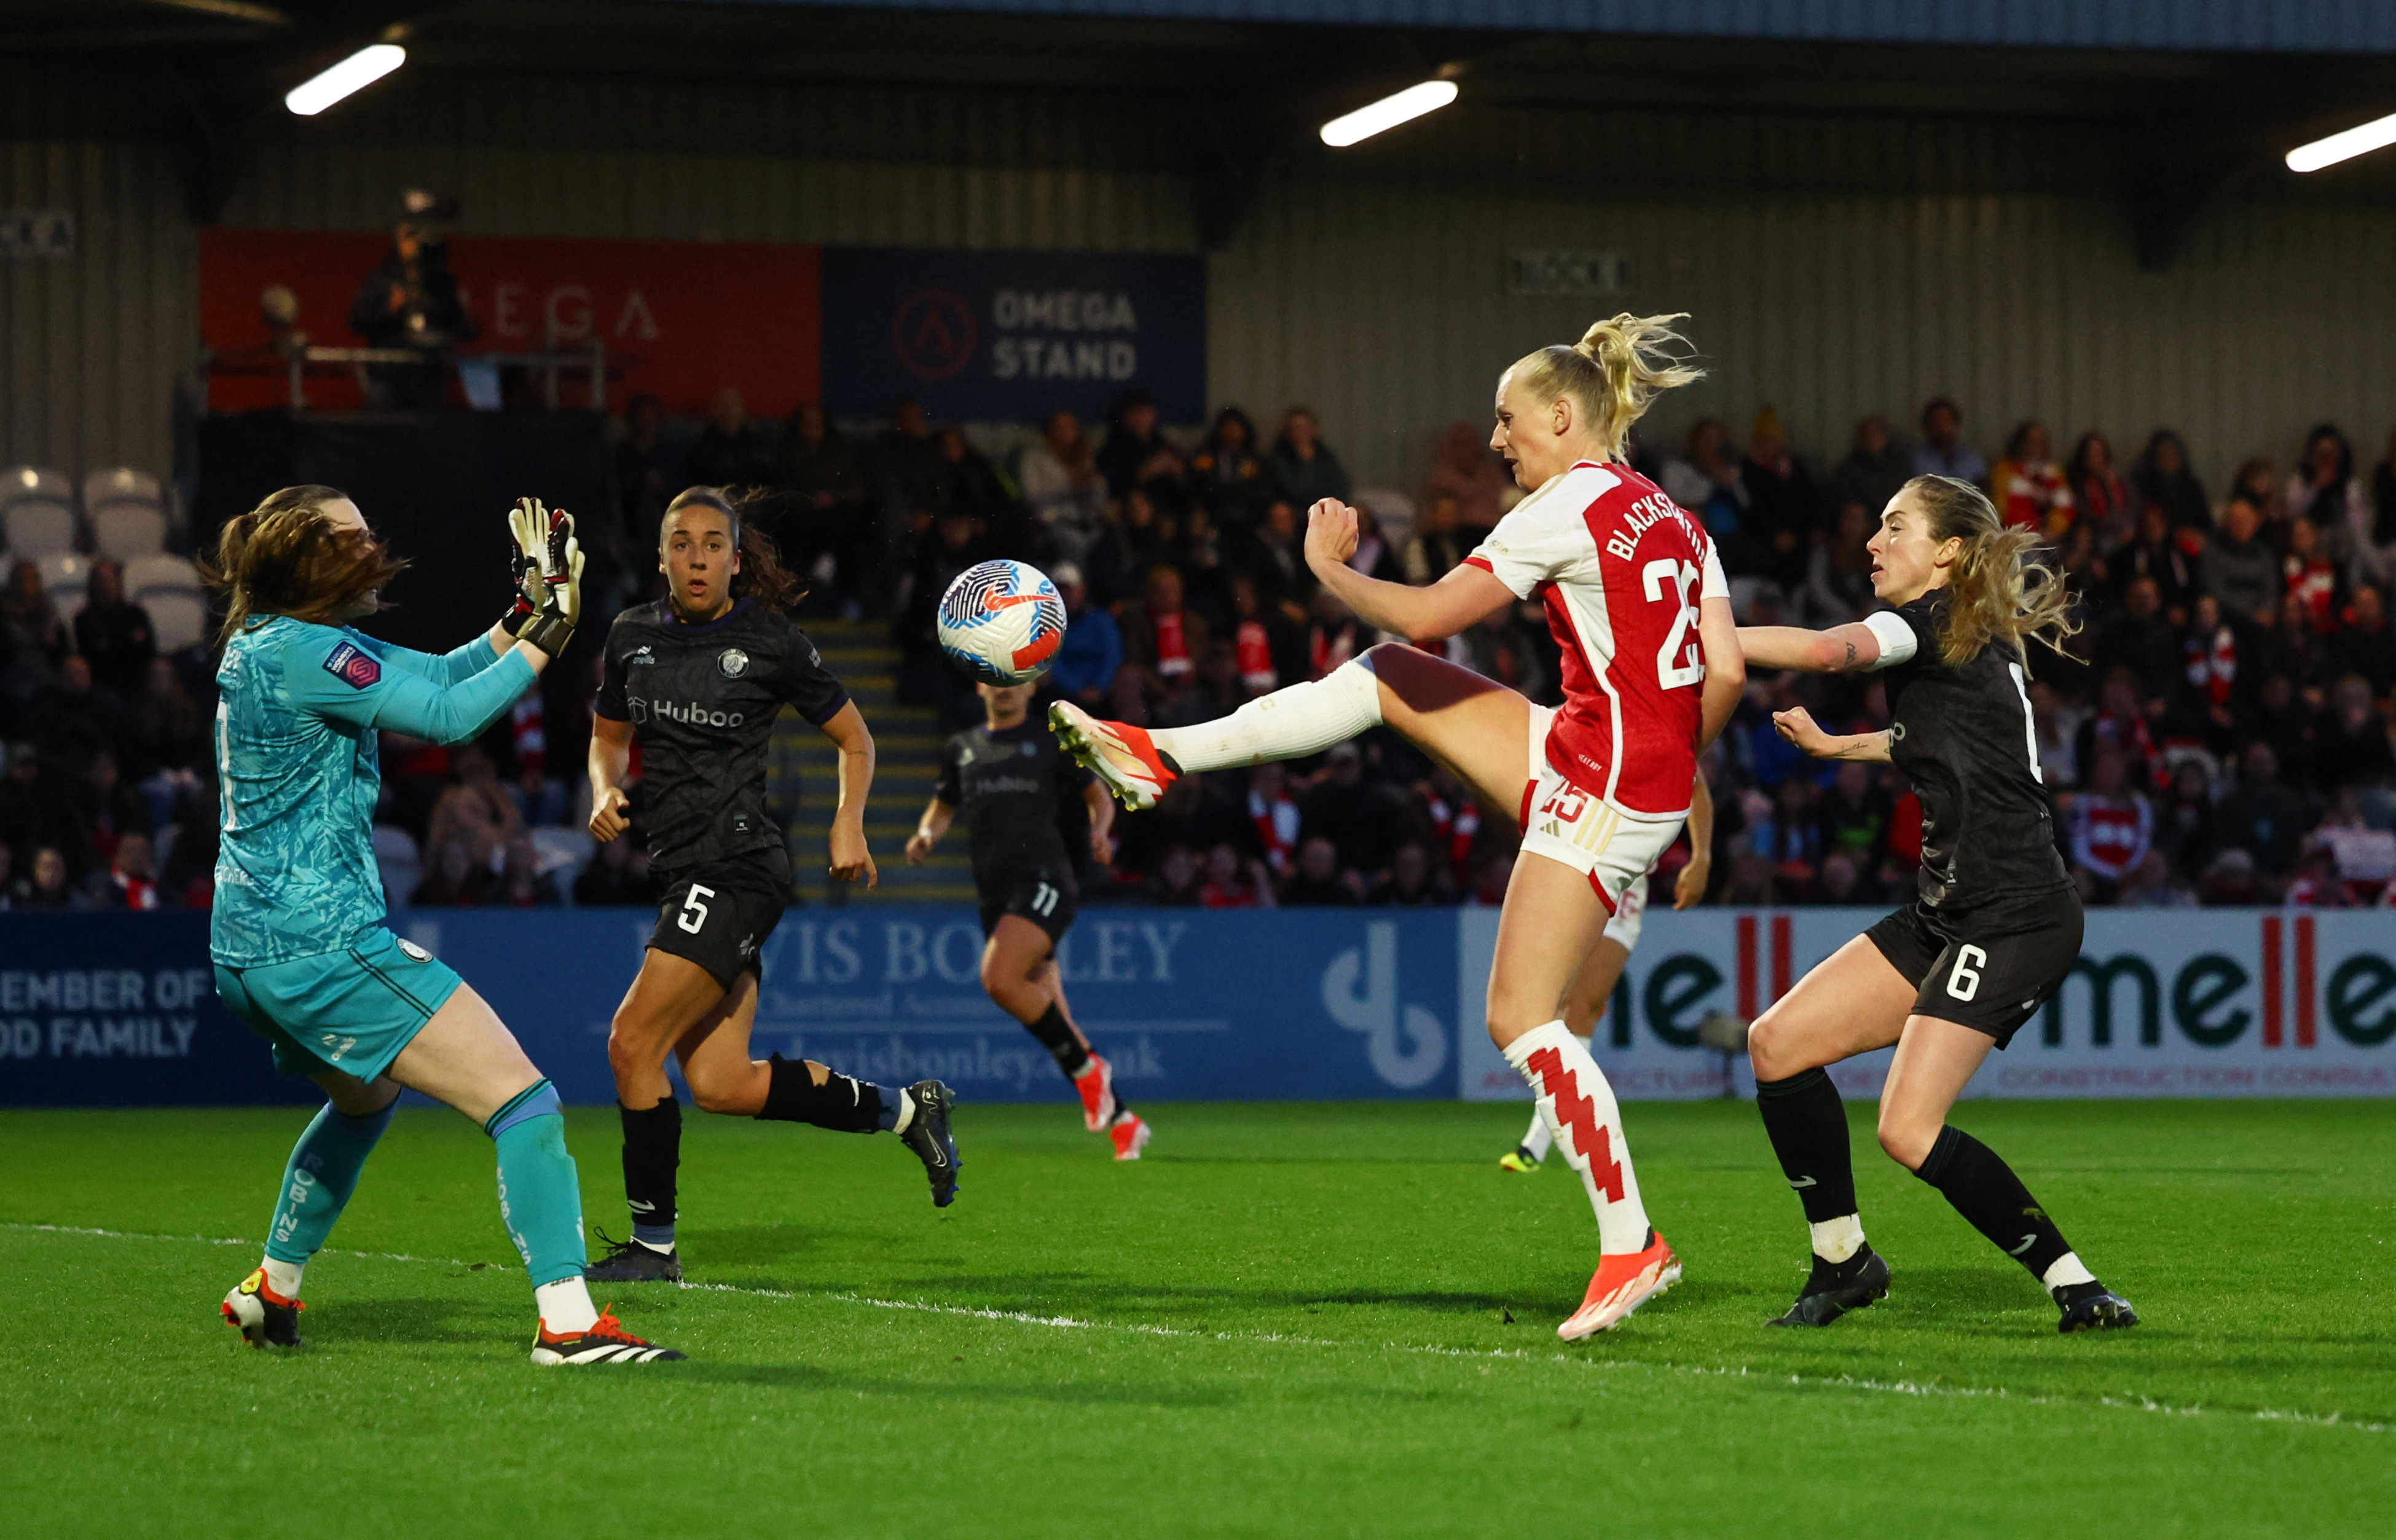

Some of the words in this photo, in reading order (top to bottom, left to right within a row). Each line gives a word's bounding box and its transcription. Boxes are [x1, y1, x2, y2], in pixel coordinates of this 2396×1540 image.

[457, 284, 658, 339] EGA
[994, 289, 1137, 332] OMEGA
[992, 339, 1137, 381] STAND
[653, 700, 744, 728] Huboo
[677, 884, 715, 935] 5
[1031, 881, 1059, 917] 11
[886, 923, 1186, 984] BOLEY
[1946, 945, 1987, 1002] 6
[0, 970, 147, 1010] EMBER
[154, 970, 208, 1009] OF
[52, 1017, 197, 1058] FAMILY
[275, 1152, 324, 1243] ROBINS
